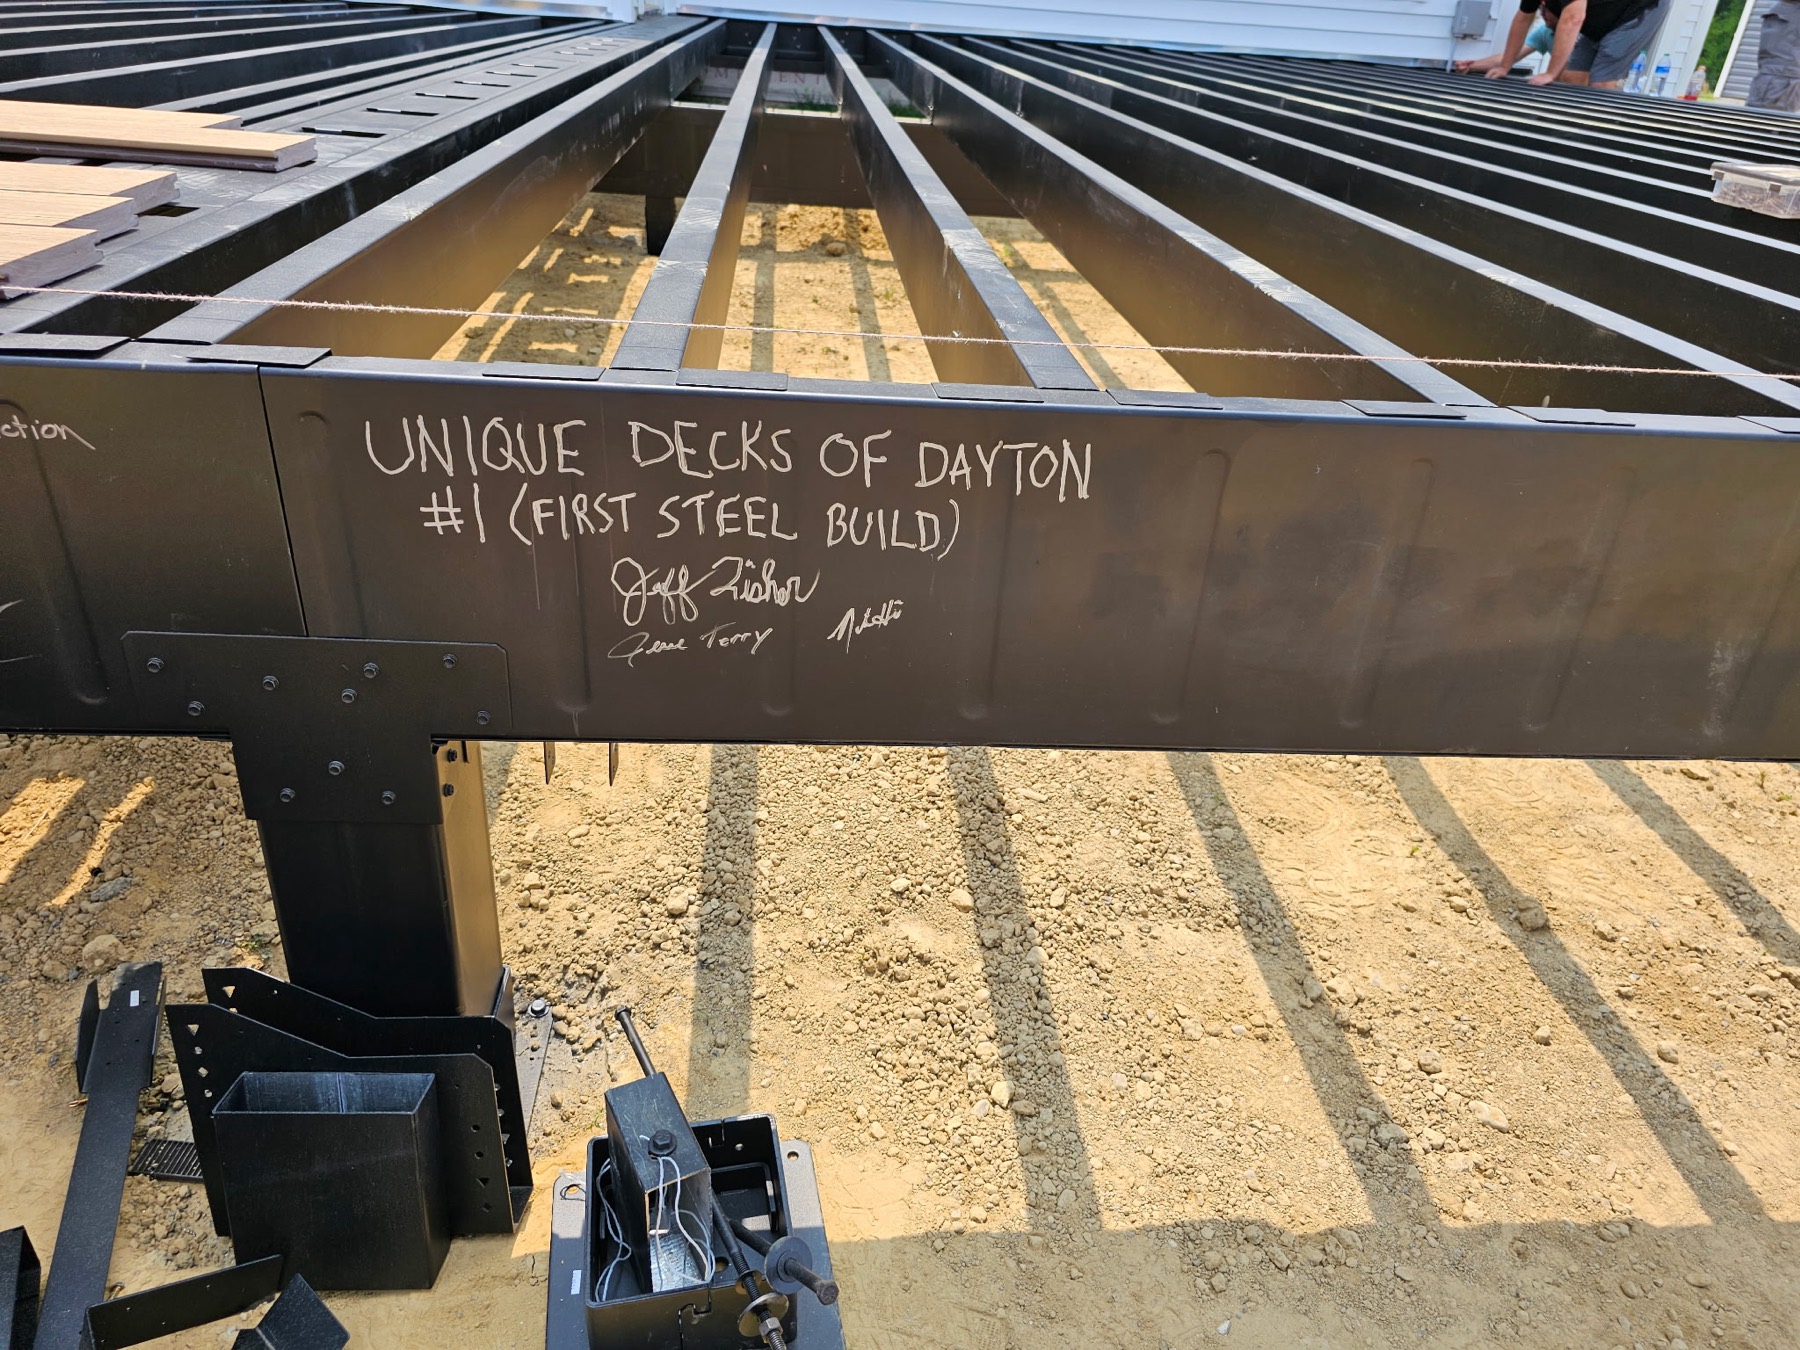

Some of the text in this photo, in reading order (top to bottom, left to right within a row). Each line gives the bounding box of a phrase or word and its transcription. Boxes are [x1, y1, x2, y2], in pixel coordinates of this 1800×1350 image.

[365, 414, 1091, 502] UNIQUE DECKS OF DAYTON
[420, 482, 960, 561] #1 (FIRST STEEL BUILD)
[611, 556, 718, 626] Jeff
